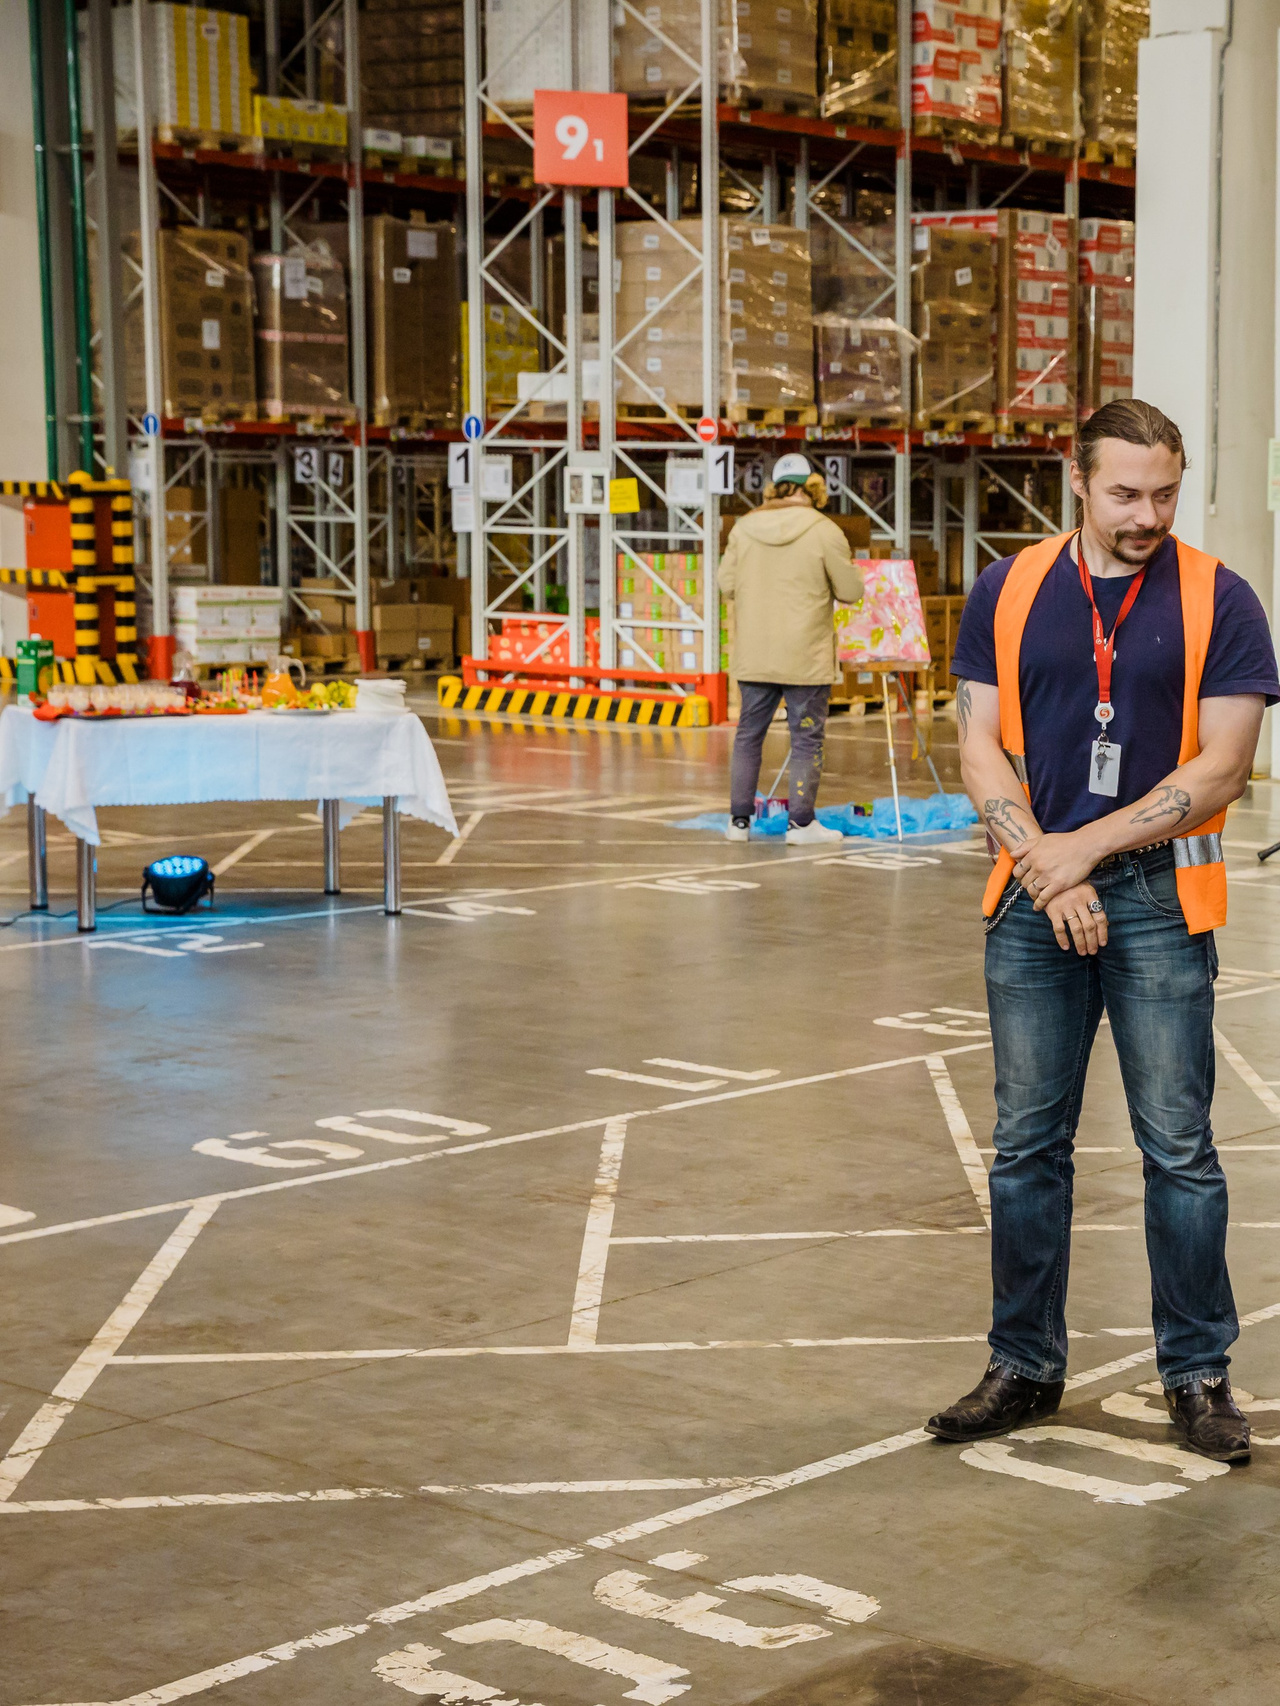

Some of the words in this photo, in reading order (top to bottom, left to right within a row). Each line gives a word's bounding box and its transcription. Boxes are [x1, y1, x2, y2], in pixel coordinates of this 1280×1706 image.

[456, 448, 470, 484] 1
[715, 451, 729, 489] 1
[615, 875, 762, 895] 16
[371, 1549, 882, 1706] 06
